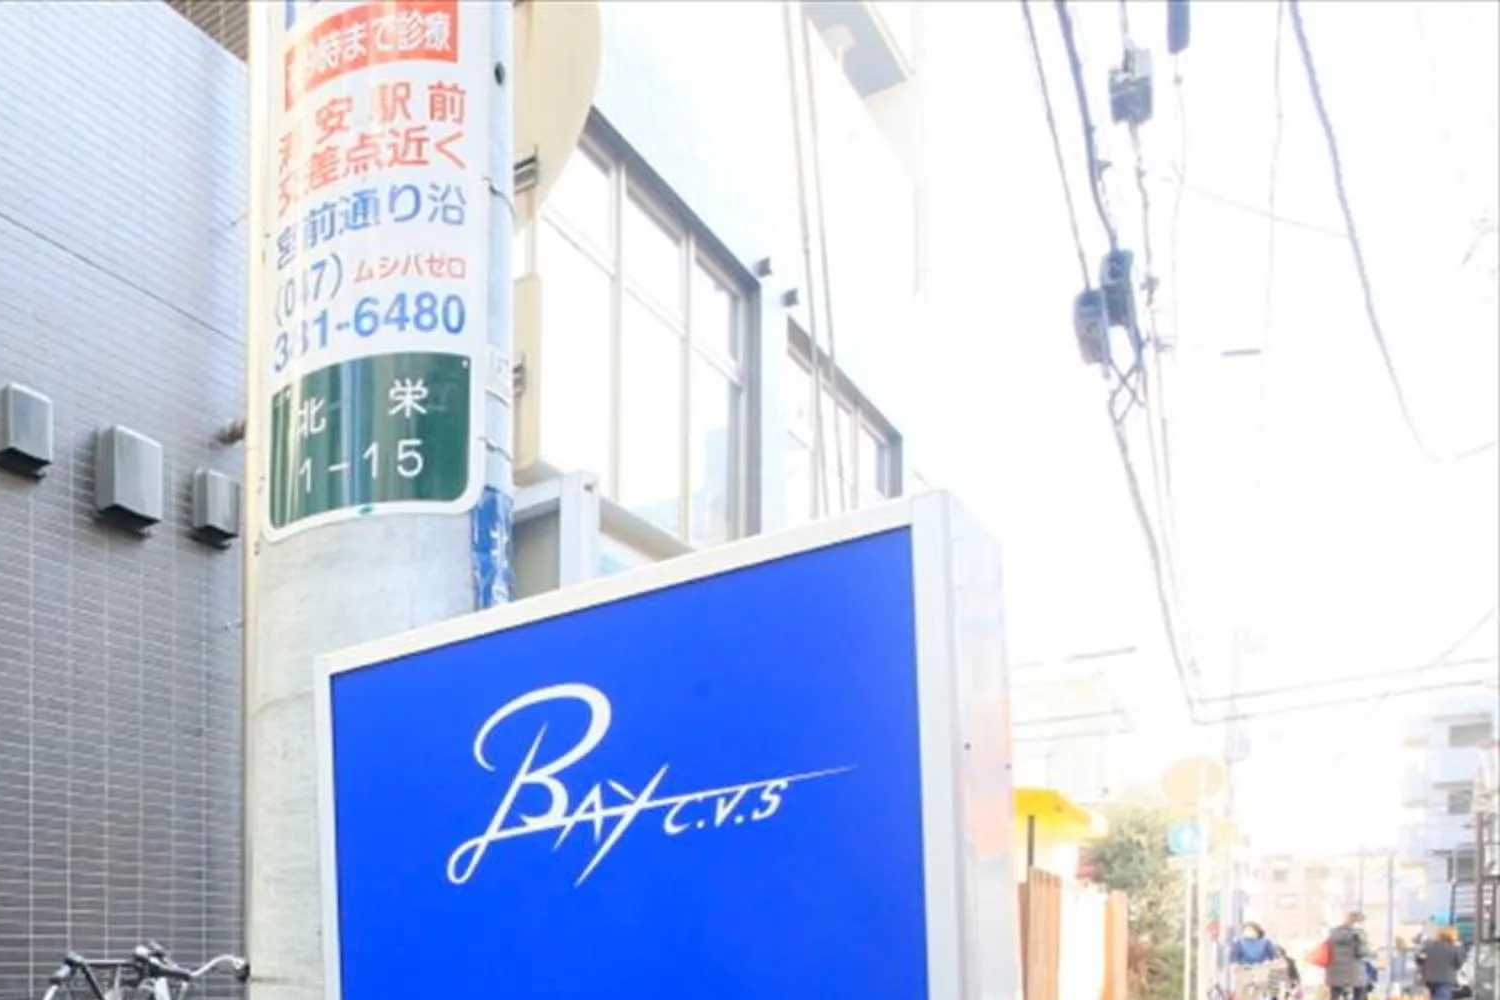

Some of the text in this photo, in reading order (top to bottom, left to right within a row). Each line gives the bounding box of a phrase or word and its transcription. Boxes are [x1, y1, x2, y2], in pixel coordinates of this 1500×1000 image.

[298, 378, 429, 437] 北栄
[299, 439, 425, 494] 1-15
[446, 682, 670, 888] BAY
